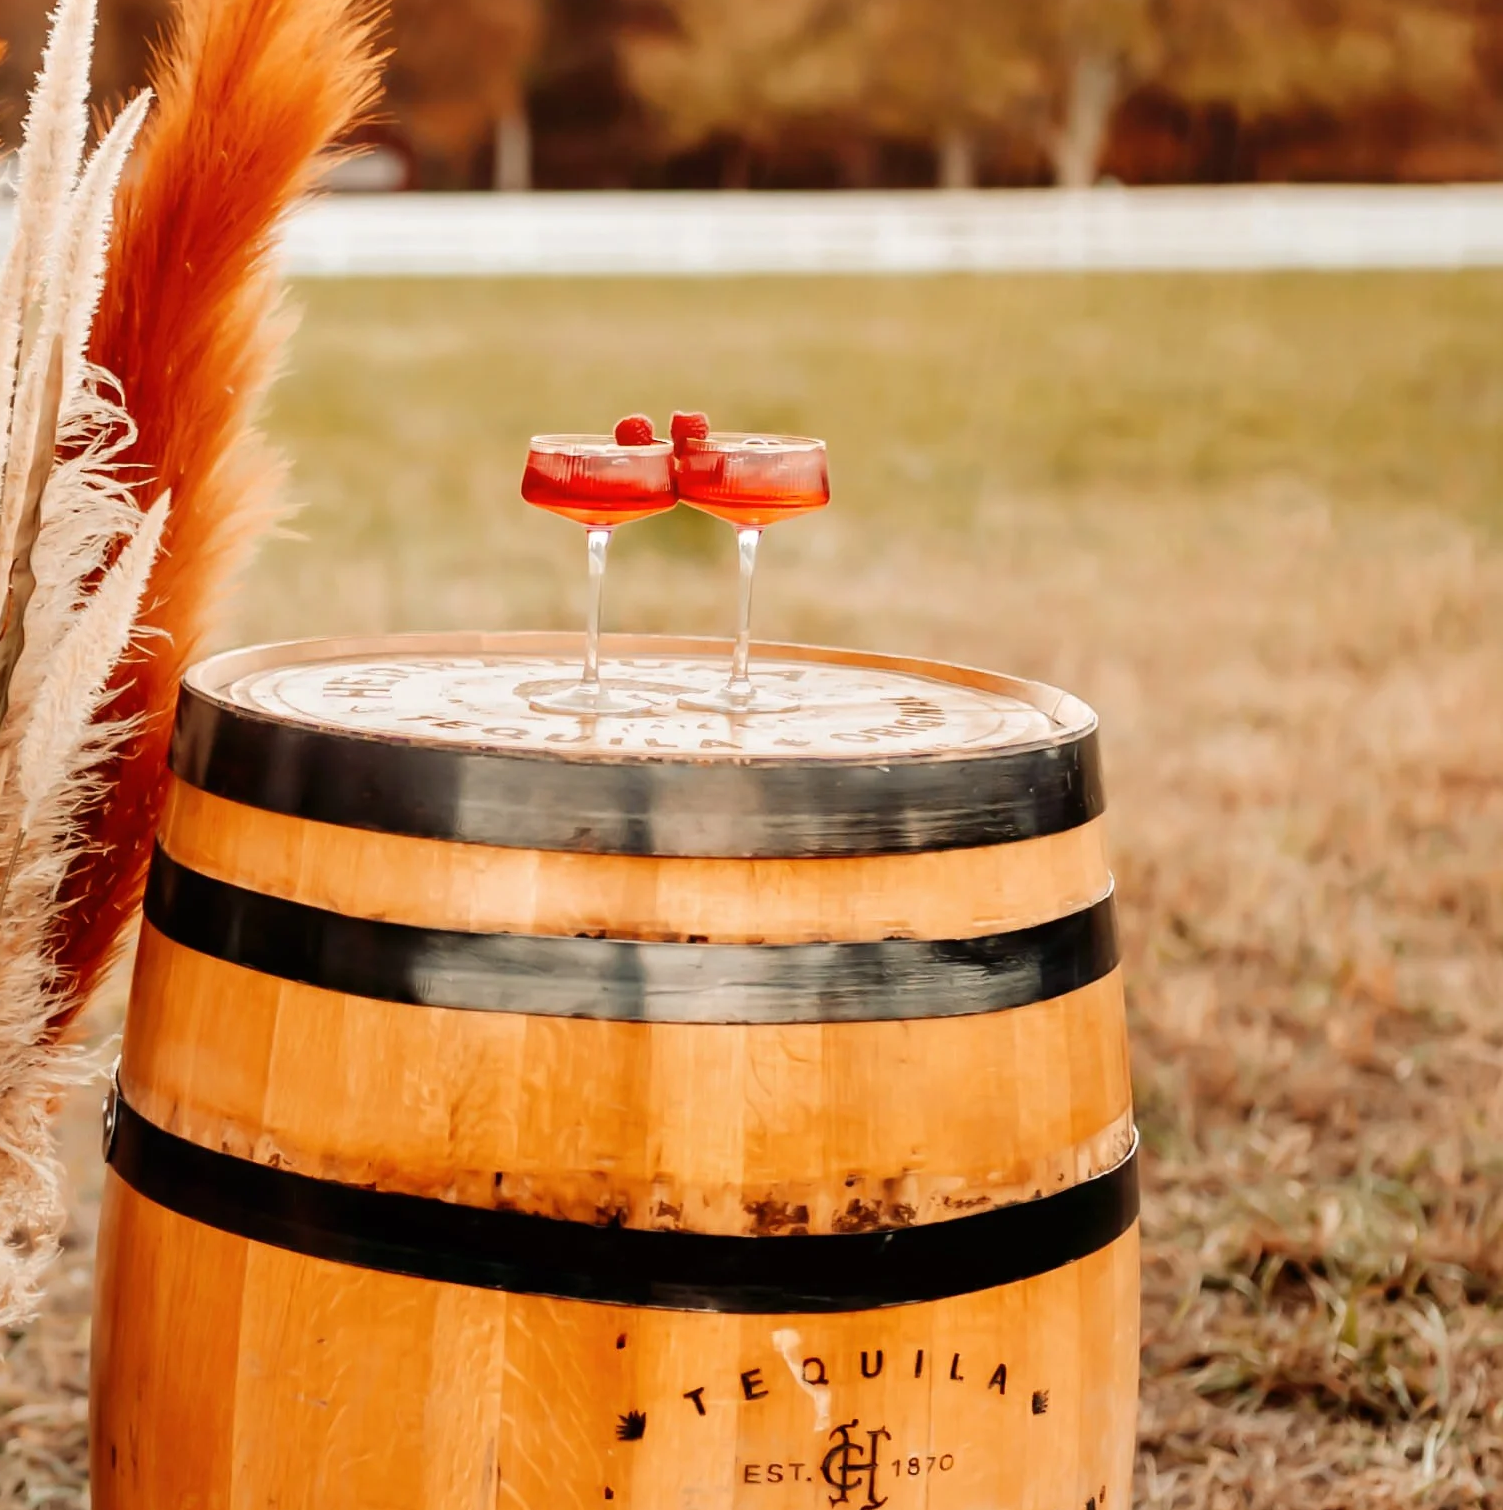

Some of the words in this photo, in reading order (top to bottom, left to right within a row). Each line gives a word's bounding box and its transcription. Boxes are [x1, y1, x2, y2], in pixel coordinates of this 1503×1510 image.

[397, 714, 743, 750] TEQUILA
[830, 695, 946, 744] ORIGINAL
[684, 1349, 1007, 1416] TEQUILA
[744, 1463, 812, 1484] EST.
[891, 1453, 954, 1478] 1870
